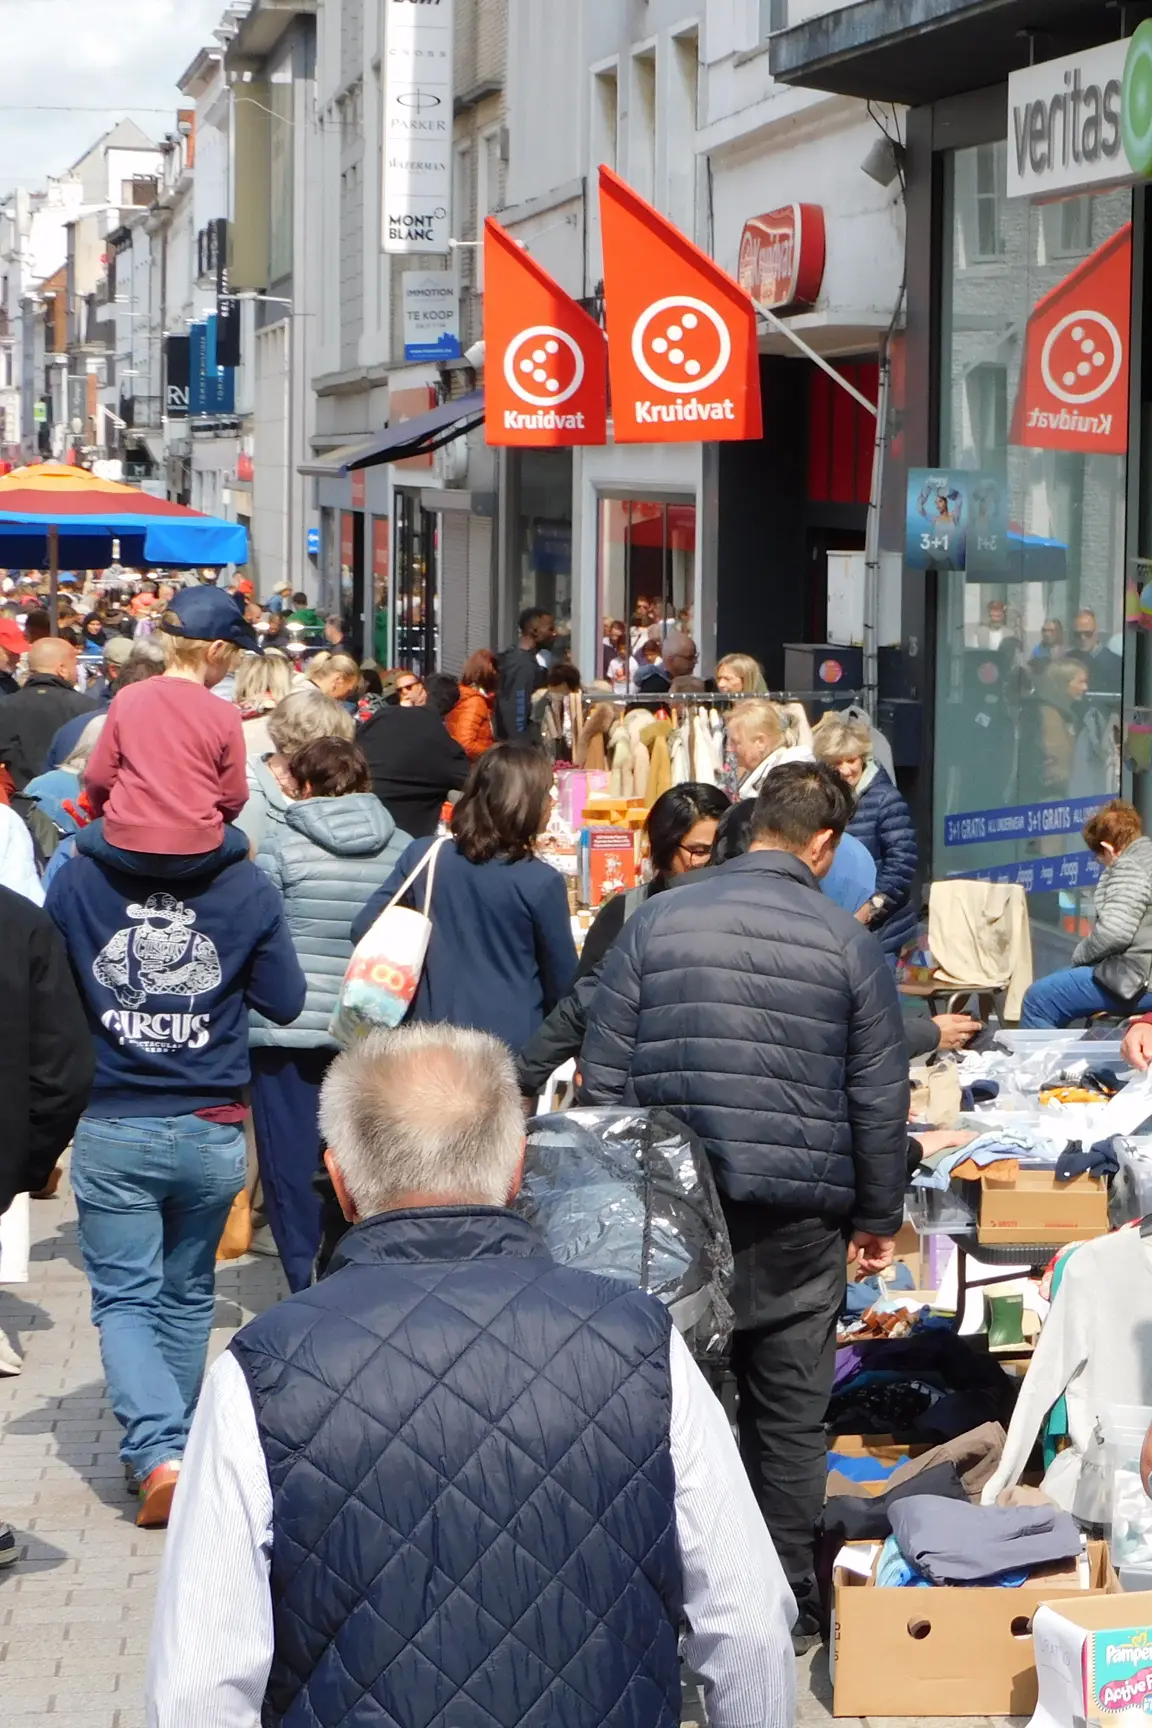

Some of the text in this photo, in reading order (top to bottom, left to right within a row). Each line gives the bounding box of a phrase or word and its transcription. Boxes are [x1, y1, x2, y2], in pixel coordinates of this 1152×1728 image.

[391, 119, 446, 131] PARKER
[1013, 67, 1121, 177] veritas
[389, 215, 433, 227] MONT
[389, 228, 433, 240] BLANC
[406, 289, 454, 297] IMMOTION
[407, 310, 454, 320] TE KOOP
[635, 398, 735, 423] Kruidvat
[504, 410, 585, 429] Kruidvat
[920, 533, 948, 550] 3+1
[961, 817, 986, 839] GRATIS
[1028, 810, 1042, 832] 3+1
[1042, 806, 1070, 830] GRATIS
[1104, 1681, 1146, 1705] Active
